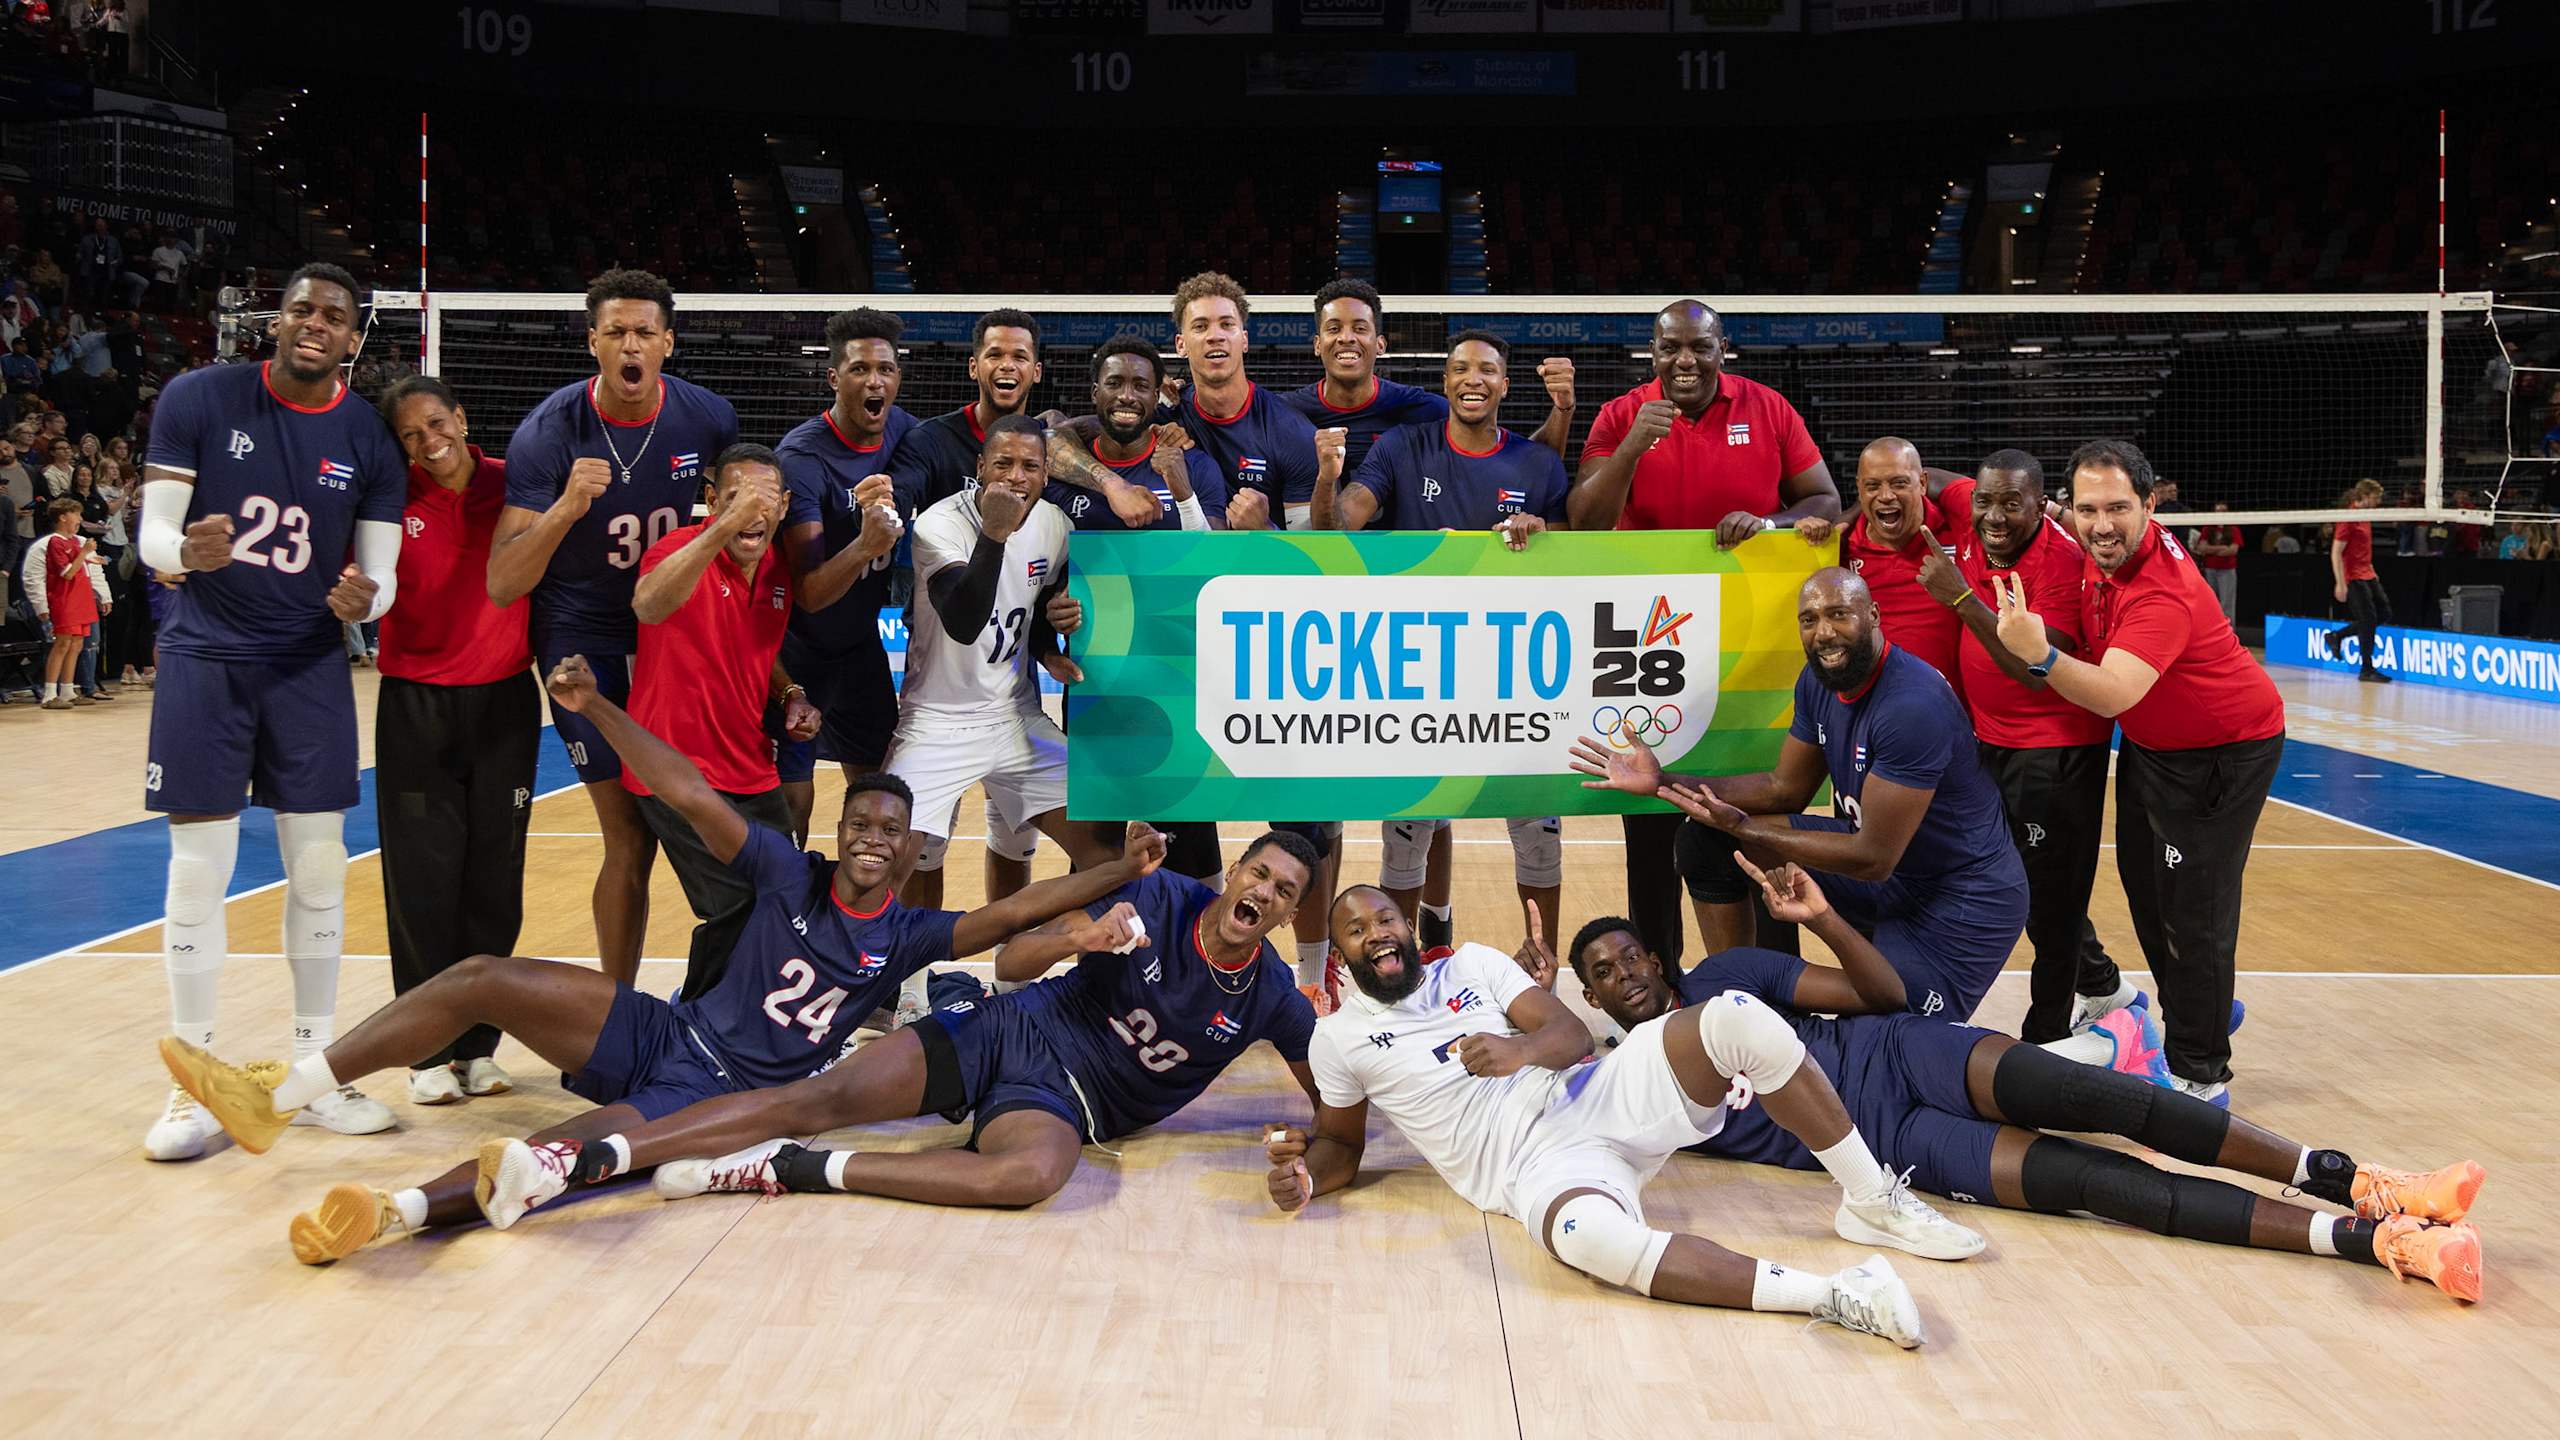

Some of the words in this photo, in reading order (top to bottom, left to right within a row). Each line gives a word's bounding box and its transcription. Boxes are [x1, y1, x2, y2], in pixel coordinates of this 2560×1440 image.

[456, 6, 534, 56] 109
[2427, 0, 2497, 35] 112
[1070, 51, 1133, 93] 110
[1677, 49, 1727, 91] 111
[1114, 322, 1167, 338] ZONE
[1257, 322, 1309, 338] ZONE
[1529, 322, 1582, 337] ZONE
[1815, 321, 1869, 337] ZONE
[1728, 433, 1751, 446] CUB
[318, 476, 348, 491] CUB
[671, 468, 697, 481] CUB
[1238, 471, 1264, 482] CUB
[1497, 503, 1522, 514] CUB
[231, 495, 313, 574] 23
[1027, 576, 1046, 587] CUB
[1593, 594, 1694, 648] LA
[1222, 609, 1469, 701] TICKET
[1487, 609, 1572, 701] TO
[2402, 636, 2467, 680] MEN'S
[1592, 649, 1686, 698] 28
[1224, 711, 1401, 745] OLYMPIC
[566, 740, 590, 766] 30
[146, 762, 164, 792] 23
[762, 957, 850, 1045] 24
[1205, 1026, 1231, 1044] CUB
